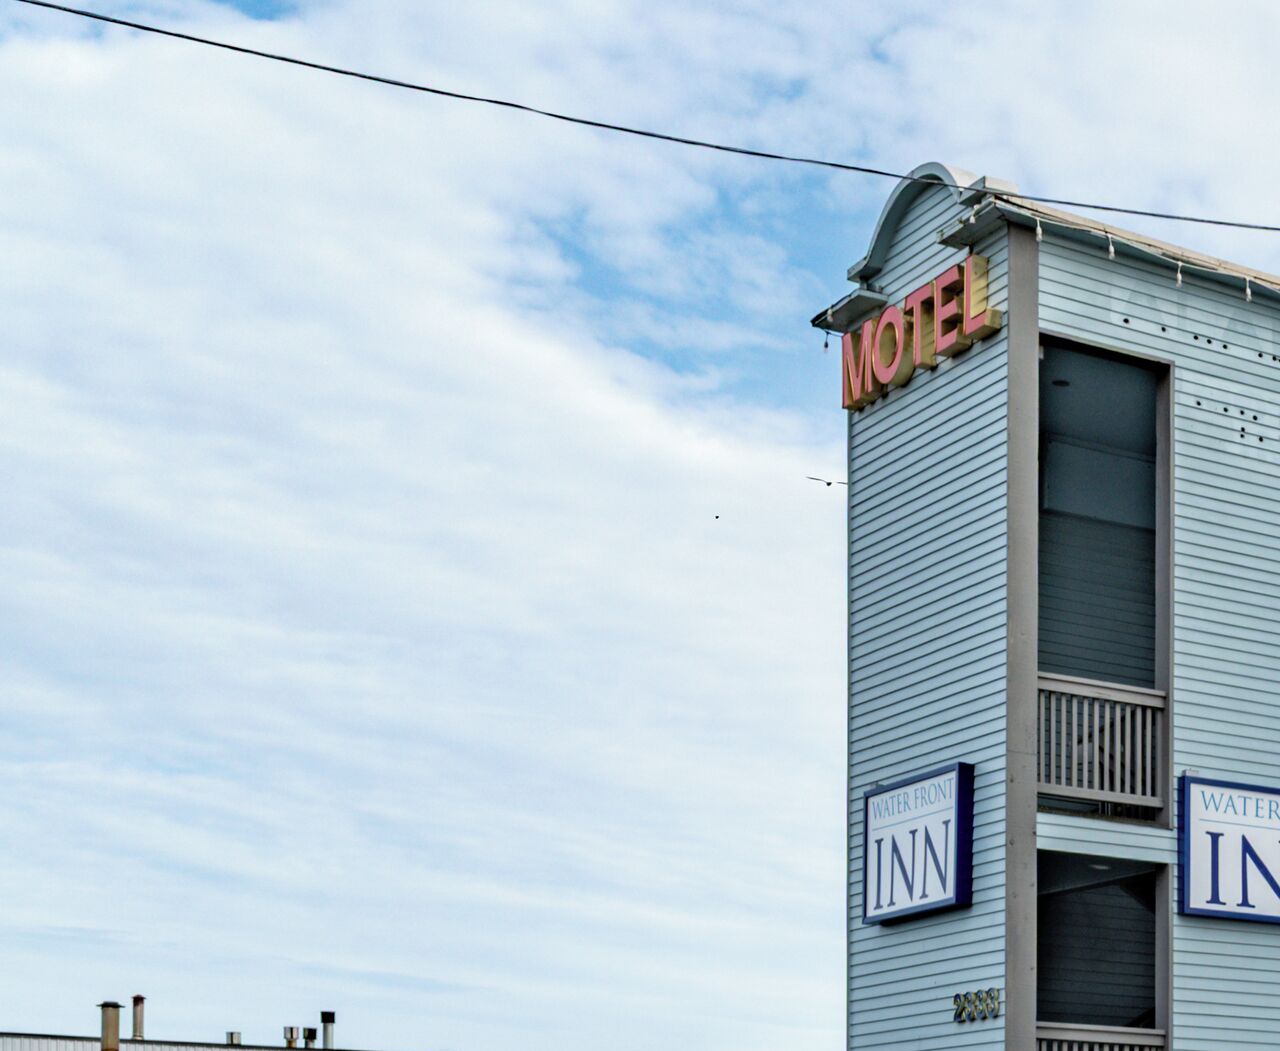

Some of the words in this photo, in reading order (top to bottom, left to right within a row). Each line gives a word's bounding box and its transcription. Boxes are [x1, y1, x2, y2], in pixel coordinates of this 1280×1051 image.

[842, 254, 999, 409] MOTEL
[872, 793, 911, 821] WATER
[914, 777, 954, 809] FRONT
[873, 819, 951, 911] INN
